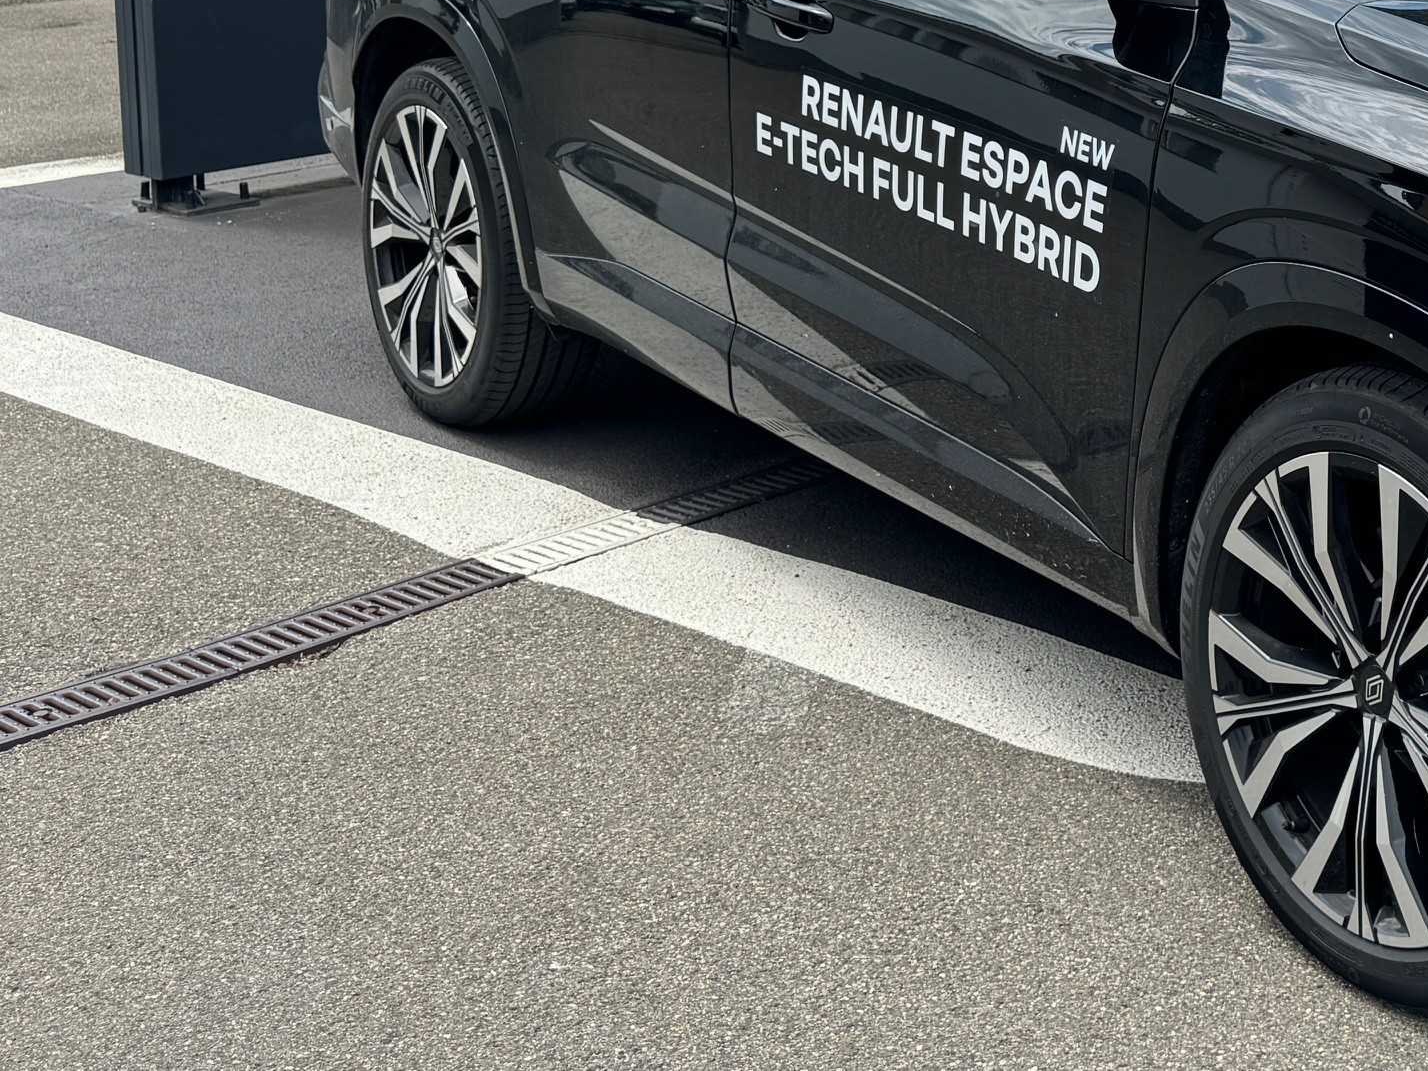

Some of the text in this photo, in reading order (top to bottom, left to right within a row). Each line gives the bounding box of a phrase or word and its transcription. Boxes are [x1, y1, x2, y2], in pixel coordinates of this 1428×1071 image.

[756, 112, 1100, 292] E-TECH FULL HYBRID
[802, 75, 1108, 233] RENAULT ESPACE
[1060, 126, 1115, 170] NEW
